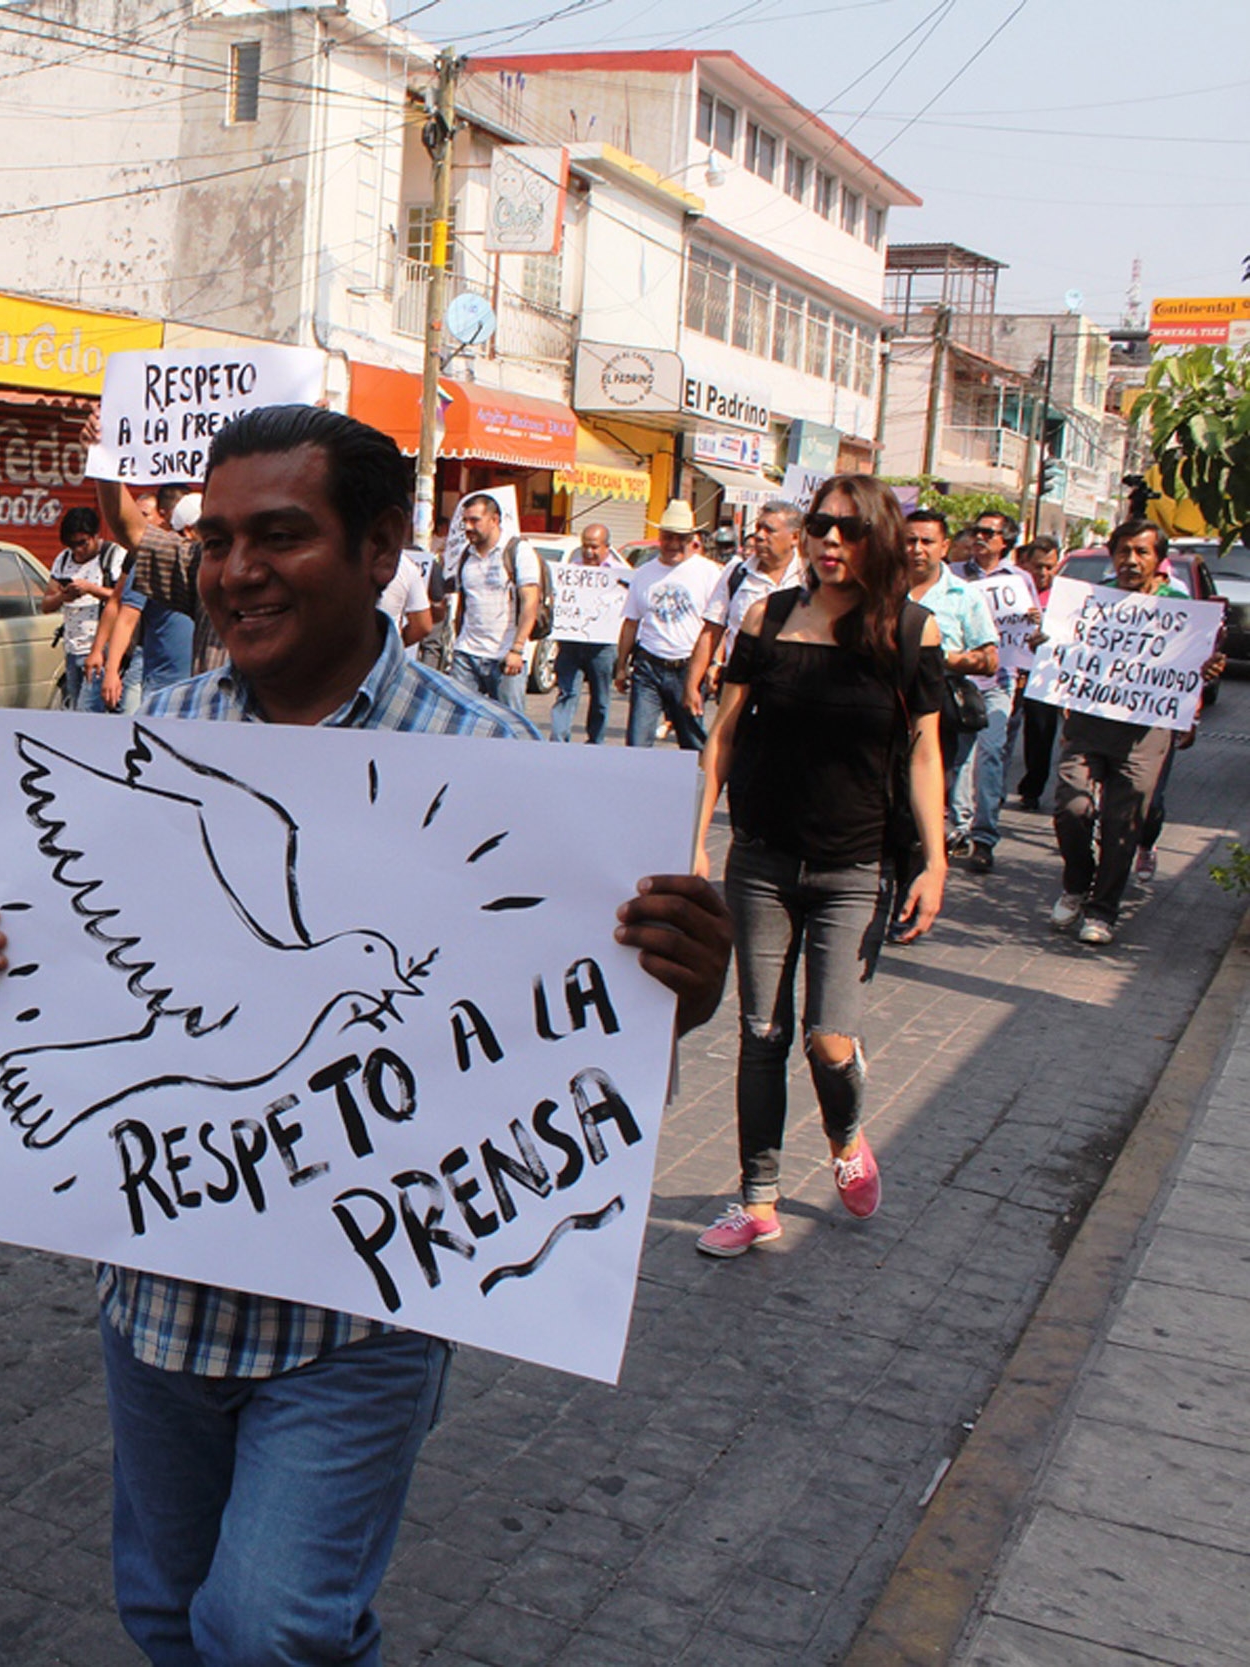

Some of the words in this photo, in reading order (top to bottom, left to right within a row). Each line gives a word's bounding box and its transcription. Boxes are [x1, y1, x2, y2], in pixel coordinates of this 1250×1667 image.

[1153, 301, 1236, 316] Continental
[145, 363, 257, 412] RESPETO
[684, 378, 700, 409] El
[706, 384, 768, 427] Padrino
[118, 417, 131, 446] A
[144, 418, 168, 445] LA
[118, 456, 137, 477] EL
[558, 568, 609, 588] RESPETO
[1081, 595, 1188, 632] EXIGIMOS
[1073, 620, 1166, 657] RESPETO
[1076, 654, 1101, 675] LA
[1055, 671, 1179, 719] PERIODISTICA
[110, 1047, 417, 1237] RESPETO
[449, 999, 503, 1072] A
[532, 957, 622, 1041] LA
[331, 1066, 644, 1313] PRENSA
